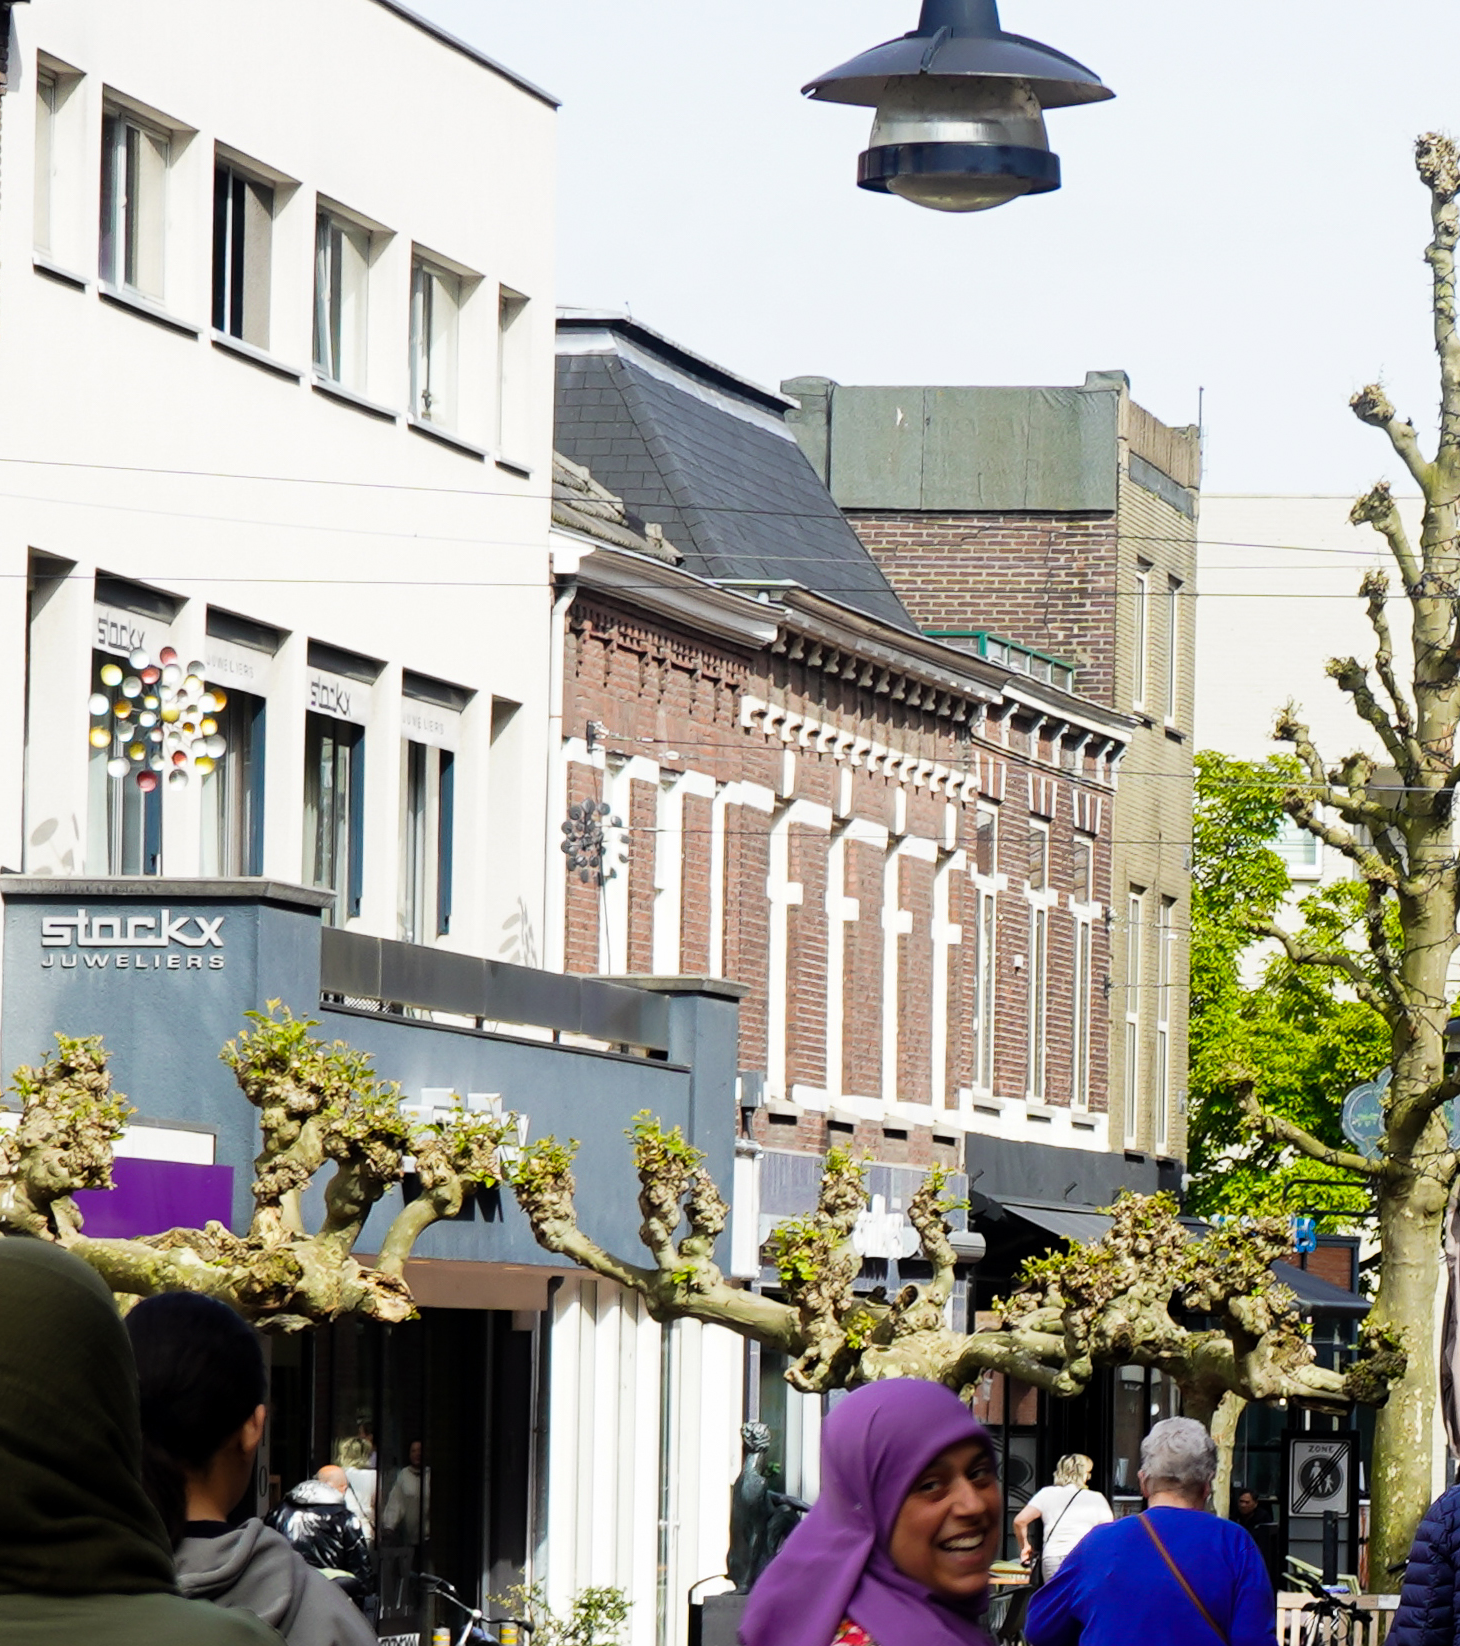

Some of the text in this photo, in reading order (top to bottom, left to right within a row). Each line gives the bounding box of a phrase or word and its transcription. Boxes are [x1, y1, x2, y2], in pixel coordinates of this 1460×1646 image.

[41, 908, 225, 947] stockx
[41, 953, 225, 969] JUWELIERS
[1308, 1444, 1334, 1453] ZONE
